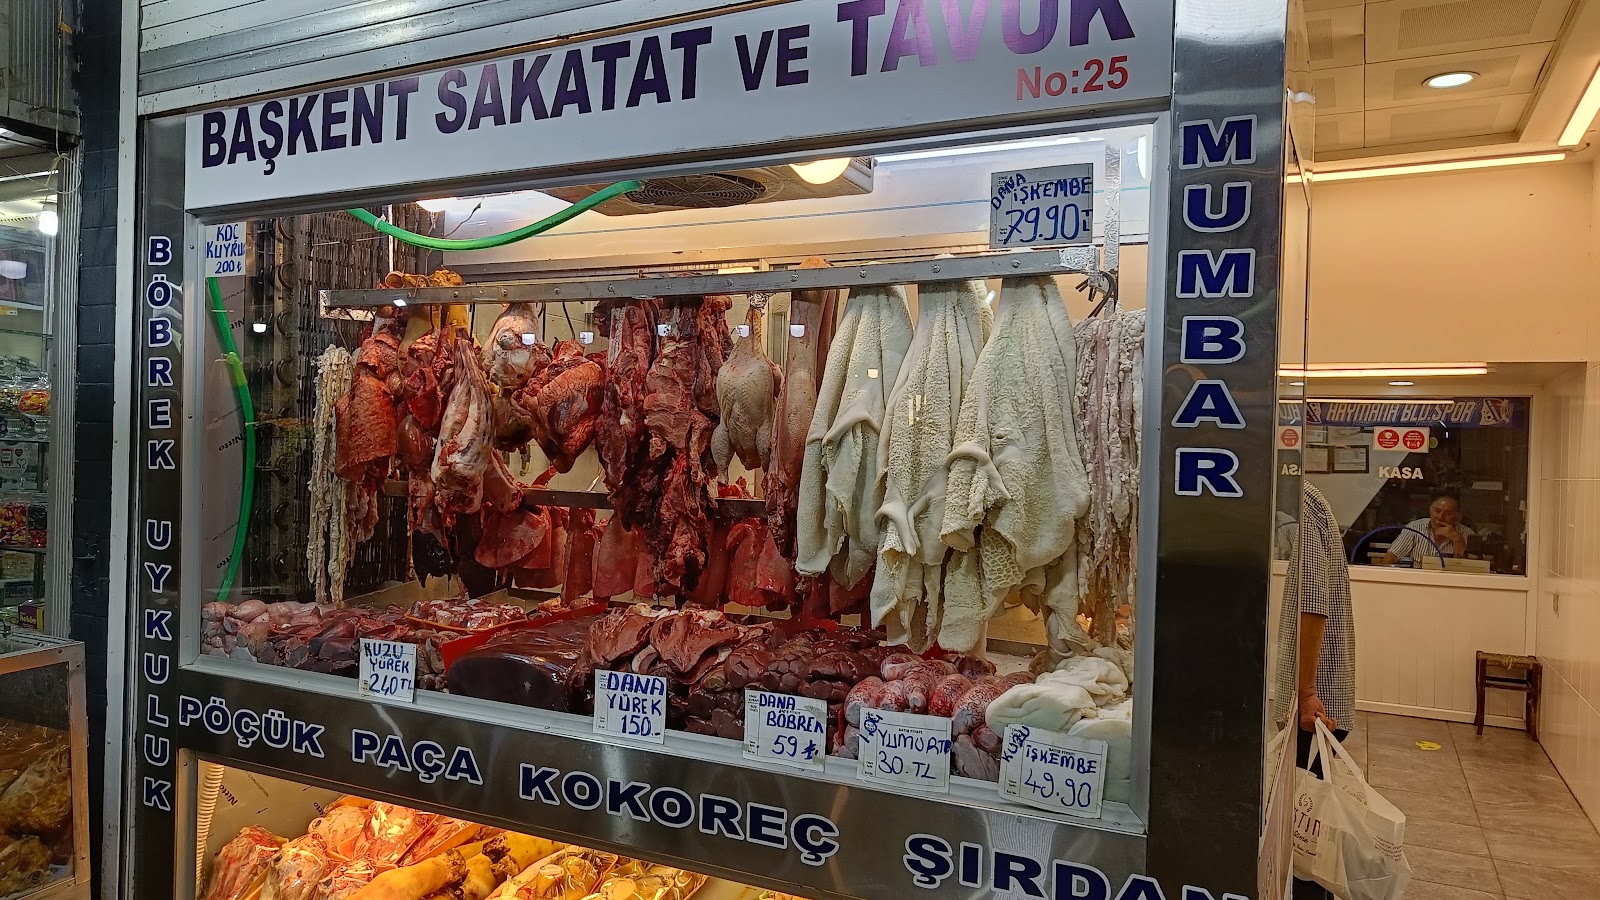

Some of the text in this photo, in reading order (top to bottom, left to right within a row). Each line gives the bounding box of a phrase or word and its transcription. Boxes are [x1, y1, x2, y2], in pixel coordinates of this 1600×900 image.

[202, 0, 1136, 175] BAŞKENT SAKATAT VE TAVUK
[1016, 55, 1129, 101] No:25
[991, 173, 1026, 210] DANA
[1003, 203, 1080, 245] 79.90
[1171, 114, 1257, 498] MUMBAR
[1378, 466, 1424, 480] KASA
[144, 236, 175, 811] BÖBREK UYKULUK
[370, 656, 409, 674] YÜREK
[607, 672, 665, 696] DANA
[606, 693, 662, 716] YÜREK
[759, 693, 796, 710] DANA
[179, 695, 325, 758] PÖÇÜK
[352, 728, 483, 785] PAÇA
[519, 763, 839, 866] KOKOREÇ
[1024, 768, 1092, 808] 49.90
